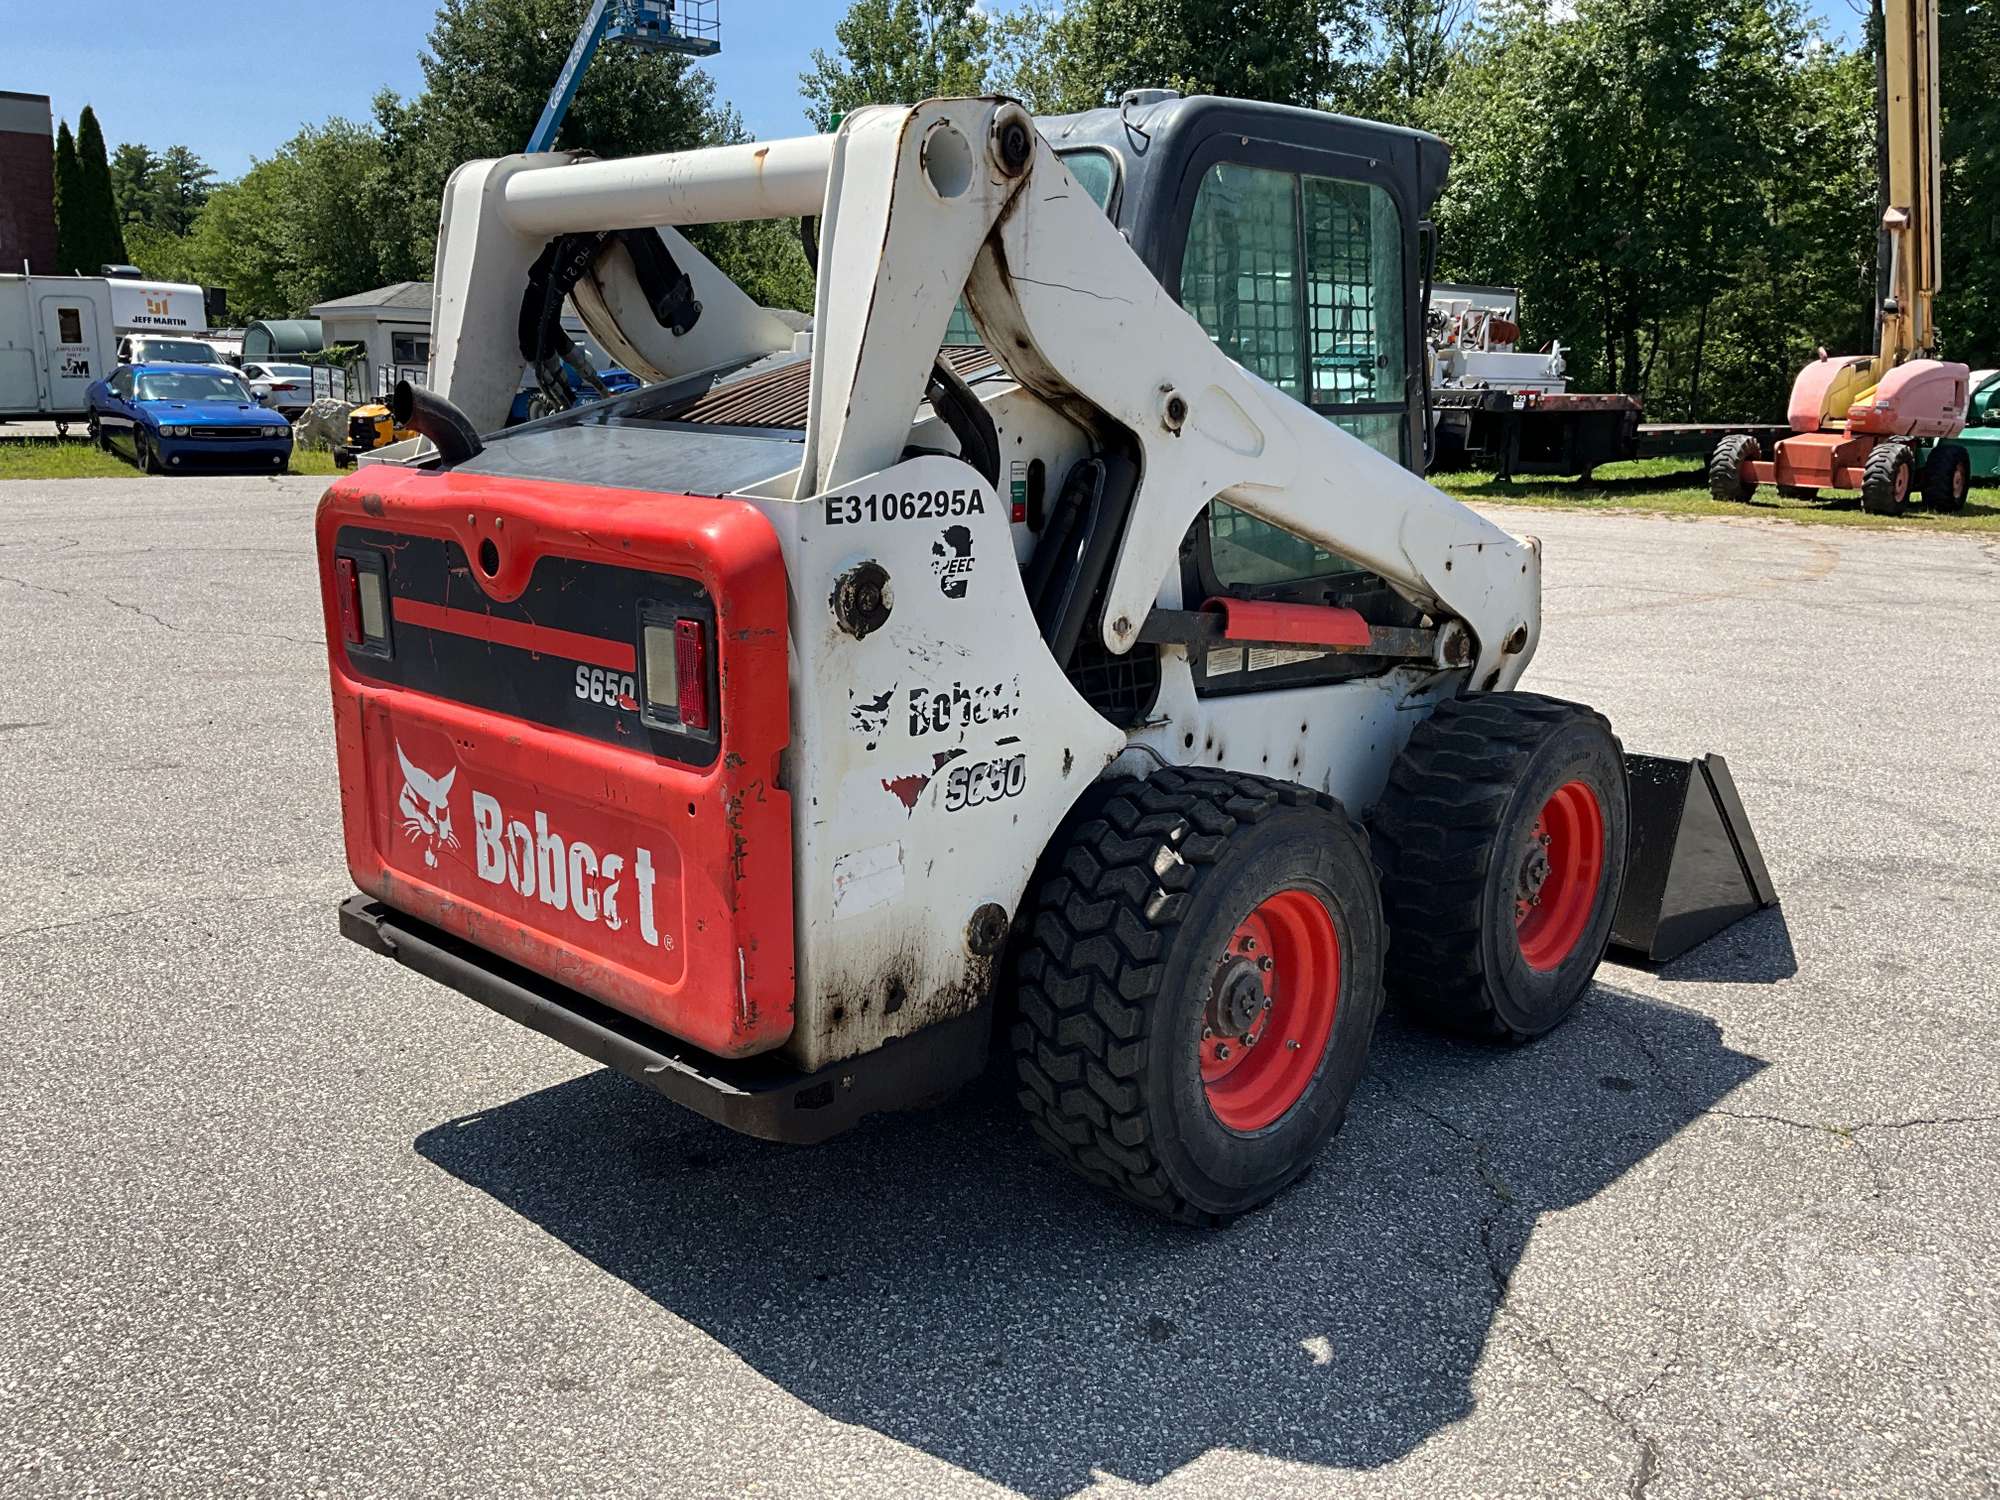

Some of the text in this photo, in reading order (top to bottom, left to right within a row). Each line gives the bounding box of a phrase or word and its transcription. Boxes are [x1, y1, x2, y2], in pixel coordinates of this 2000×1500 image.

[131, 315, 187, 326] JEFF MARTIN
[825, 488, 985, 526] E3106295A
[575, 664, 636, 711] S650
[472, 789, 660, 948] Bobcat
